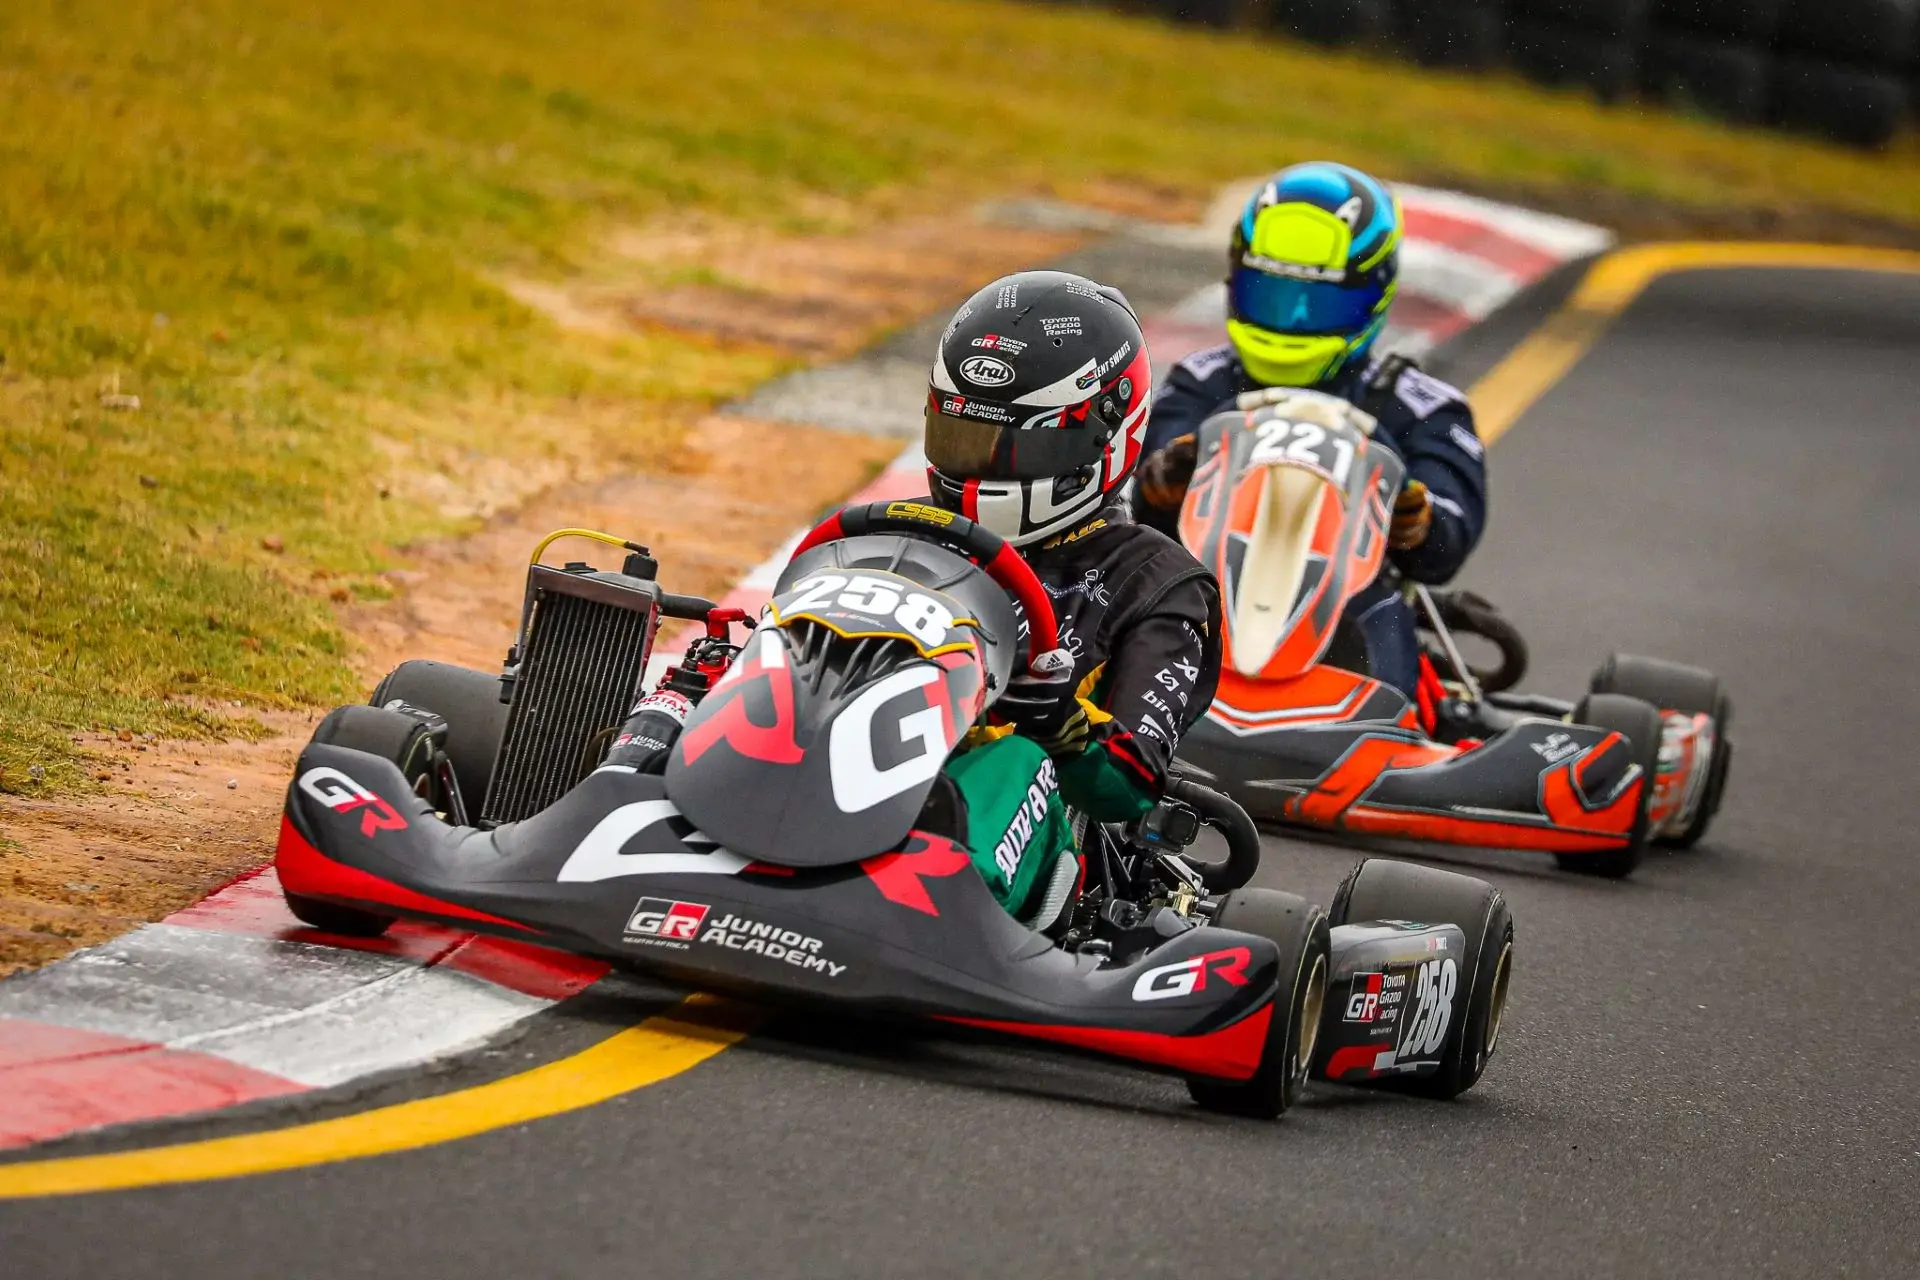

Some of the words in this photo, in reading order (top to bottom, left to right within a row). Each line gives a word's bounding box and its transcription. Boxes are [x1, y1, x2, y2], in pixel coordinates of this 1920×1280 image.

[1040, 316, 1080, 325] TOYOTA
[1043, 322, 1081, 331] GAZOO
[1045, 328, 1083, 336] Racing
[971, 337, 995, 349] GR
[996, 340, 1023, 351] GAZOO
[999, 335, 1028, 348] TOYOTA
[963, 360, 1009, 380] Arai
[943, 400, 963, 413] GR
[965, 401, 1006, 415] JUNIOR
[962, 408, 1017, 423] ACADEMY
[1250, 418, 1354, 490] 221
[779, 574, 954, 648] 258
[298, 766, 409, 839] GR
[629, 911, 700, 938] GR
[710, 913, 823, 954] JUNIOR
[701, 928, 847, 977] ACADEMY
[1131, 946, 1252, 1002] GR
[1382, 974, 1406, 988] TOYOTA
[1379, 991, 1402, 1004] GAZOO
[1346, 993, 1379, 1019] GR
[1397, 958, 1458, 1058] 258
